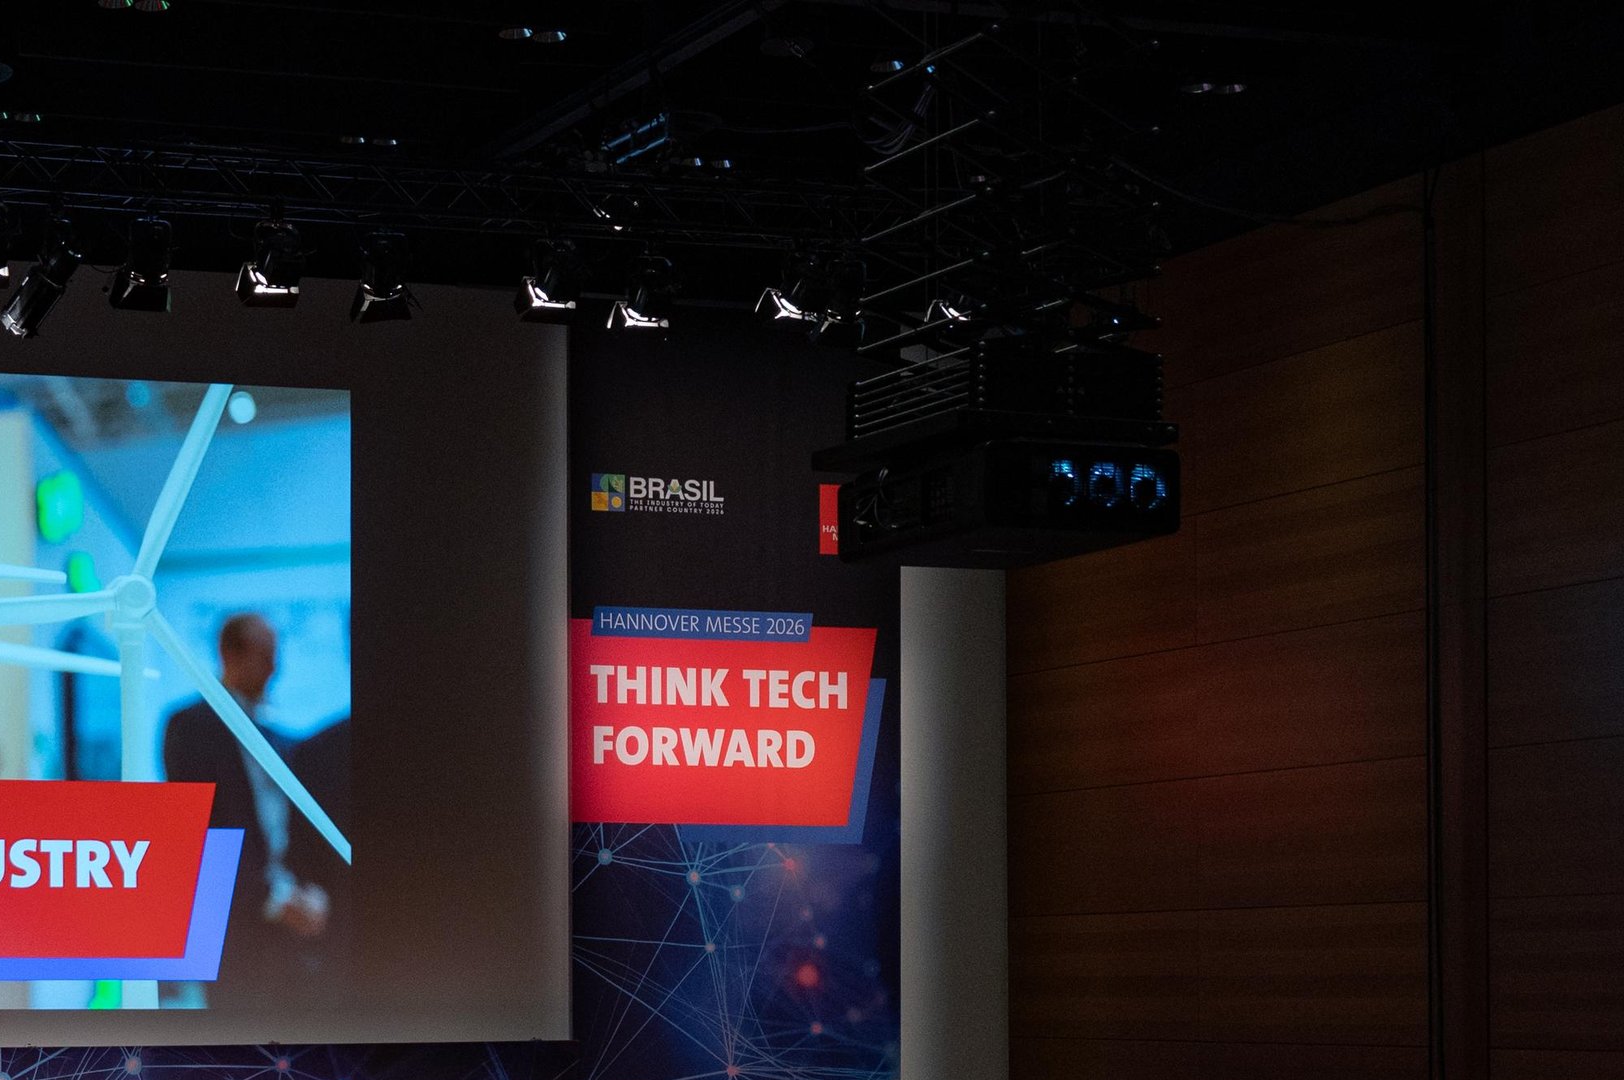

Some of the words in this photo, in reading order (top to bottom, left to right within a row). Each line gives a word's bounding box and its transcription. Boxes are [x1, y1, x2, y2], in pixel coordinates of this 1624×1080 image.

[629, 476, 724, 502] BRASIL
[600, 611, 700, 633] HANNOVER
[706, 615, 761, 635] MESSE
[766, 618, 805, 636] 2026
[590, 664, 730, 707] THINK
[742, 670, 848, 710] TECH
[592, 725, 816, 769] FORWARD
